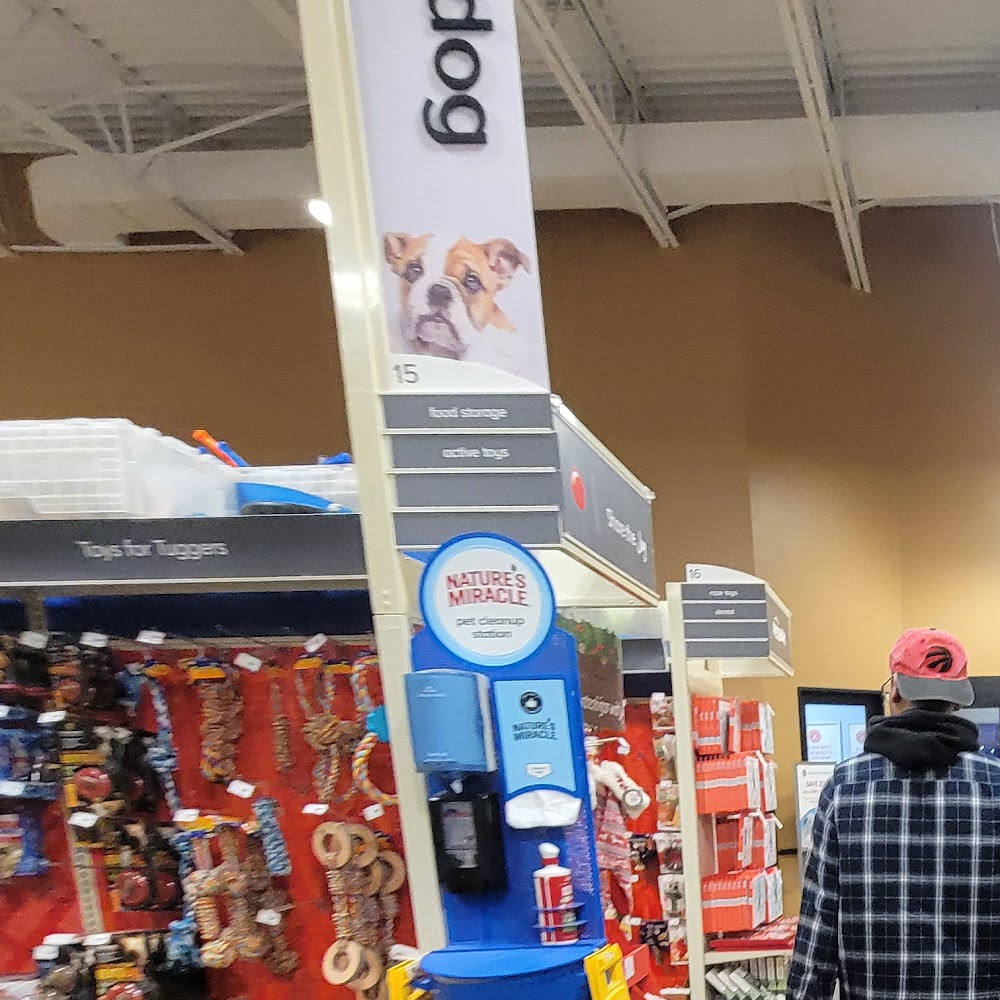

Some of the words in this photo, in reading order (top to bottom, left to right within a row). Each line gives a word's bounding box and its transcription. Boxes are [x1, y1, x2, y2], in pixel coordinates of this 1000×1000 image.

[422, 0, 494, 145] dog
[393, 363, 419, 384] 15
[427, 406, 459, 418] food
[459, 406, 508, 420] storage
[481, 446, 510, 461] toys
[75, 540, 124, 562] Toys
[122, 539, 151, 557] for
[150, 539, 230, 561] Tuggers
[446, 564, 526, 590] NATURE'S
[688, 568, 702, 580] 16
[448, 587, 531, 608] MIRACLE
[455, 616, 477, 628] pet
[478, 616, 526, 628] cleanup
[471, 628, 513, 639] station
[513, 730, 558, 741] MIRACLE
